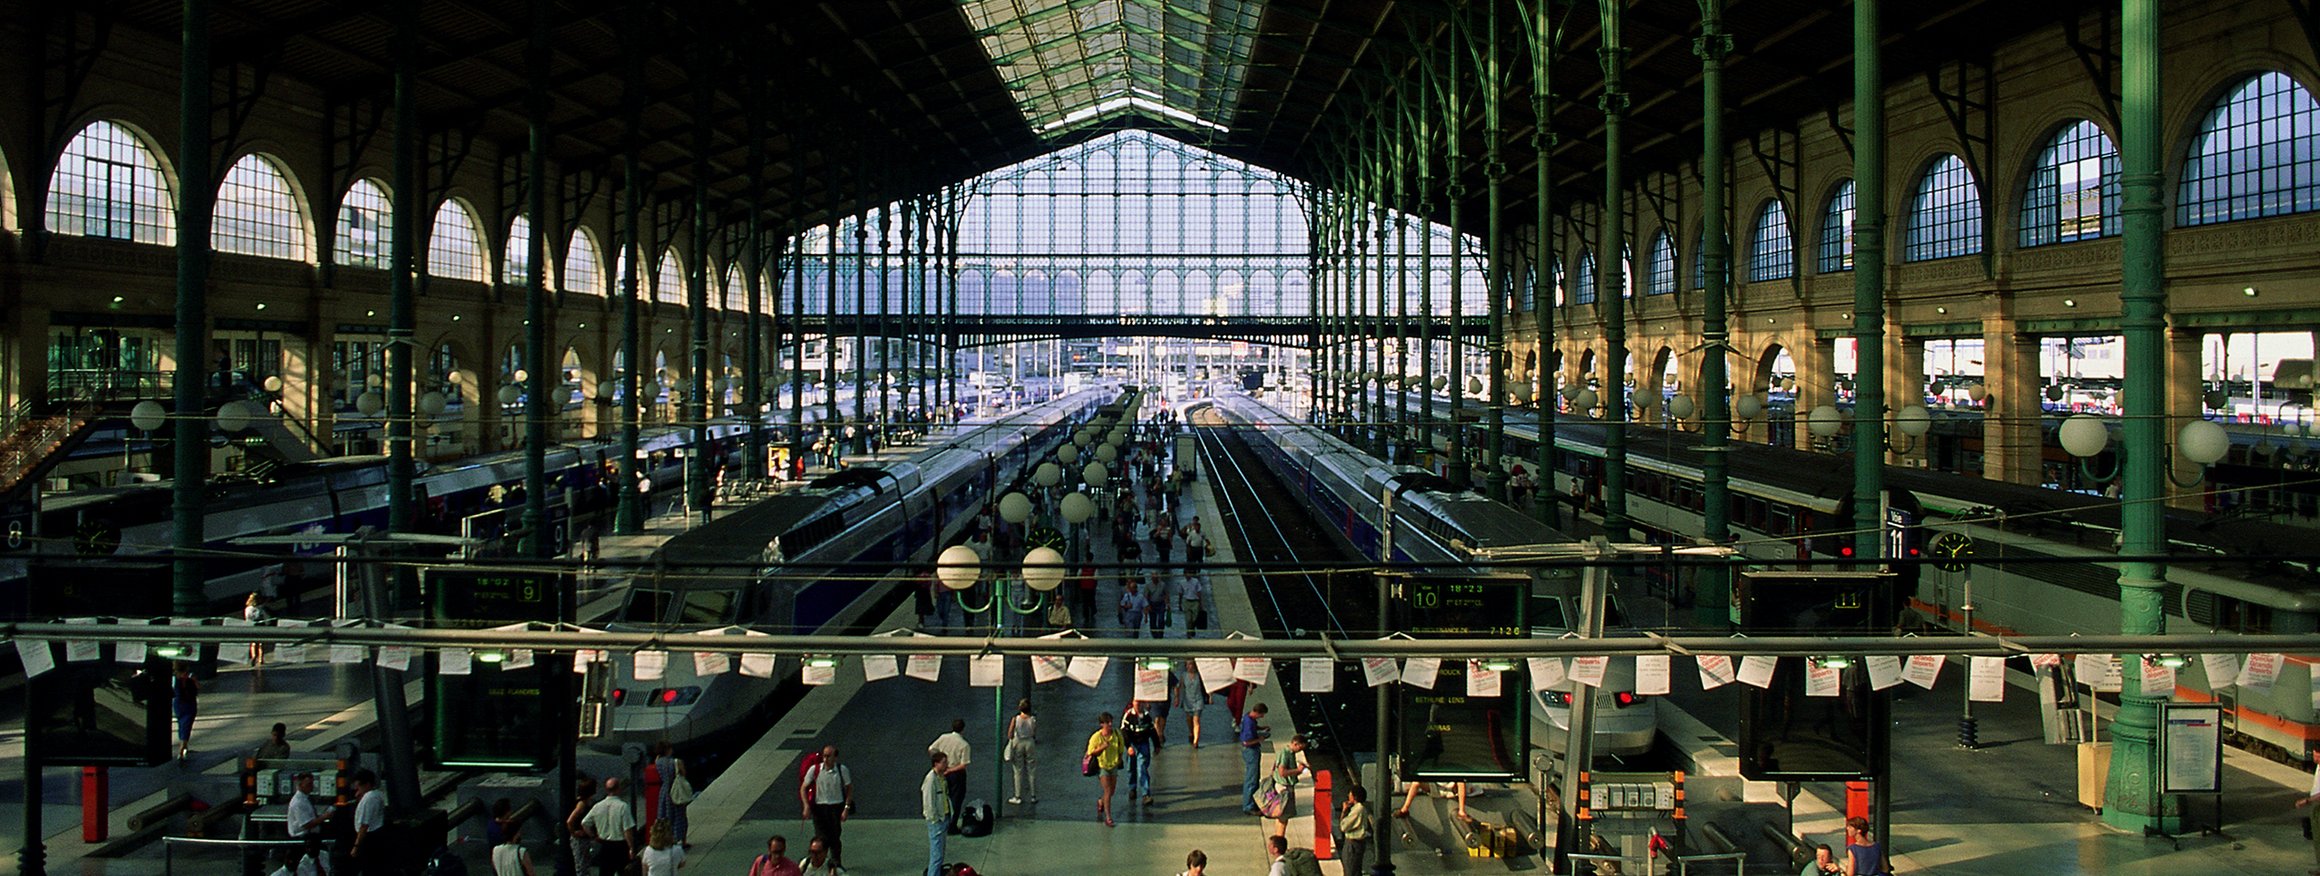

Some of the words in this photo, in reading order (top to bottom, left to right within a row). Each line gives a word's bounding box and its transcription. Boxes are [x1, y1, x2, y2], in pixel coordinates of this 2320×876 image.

[8, 519, 22, 549] 8
[554, 525, 563, 553] 9
[1890, 529, 1903, 560] 11
[523, 586, 534, 600] 9
[1416, 592, 1436, 606] 10
[1840, 592, 1856, 606] 11
[1490, 627, 1520, 635] 7126
